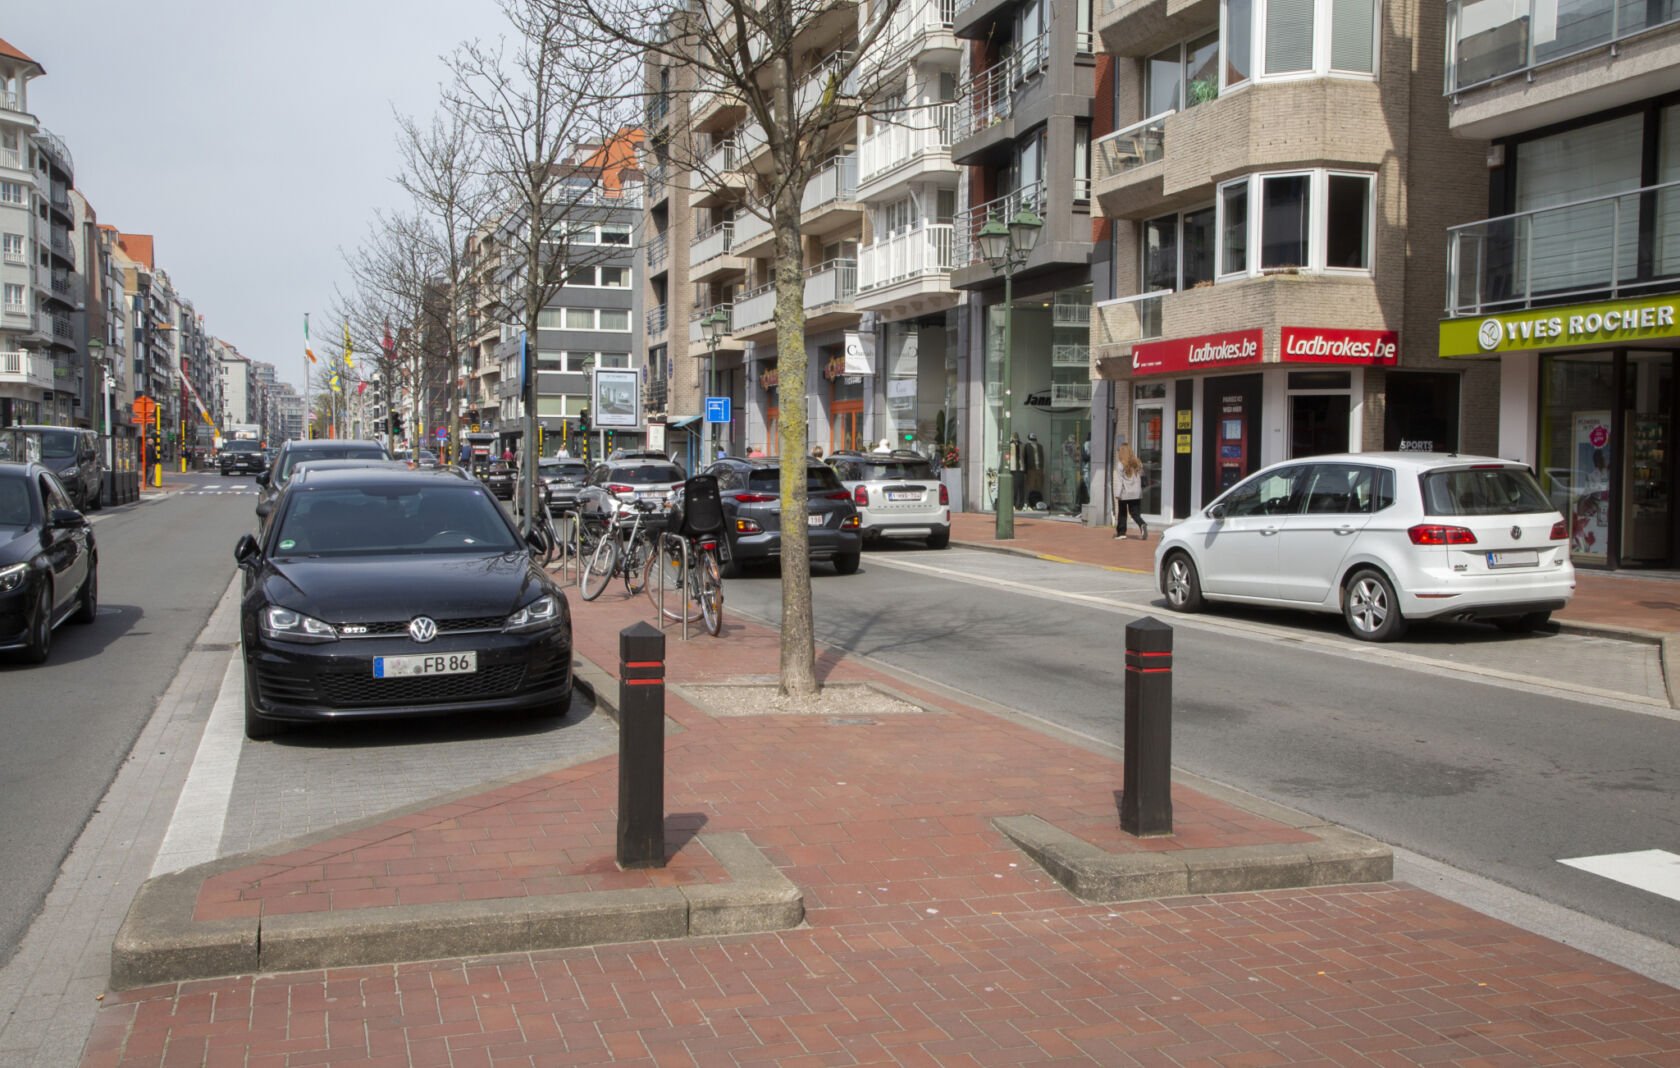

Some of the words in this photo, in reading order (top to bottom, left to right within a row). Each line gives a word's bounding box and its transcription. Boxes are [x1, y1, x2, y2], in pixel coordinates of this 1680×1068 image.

[1506, 317, 1562, 340] YVES
[1568, 305, 1675, 336] ROCHER
[1188, 338, 1257, 362] Ladbrokes.be
[1286, 334, 1396, 359] Ladbrokes.be
[1400, 440, 1433, 450] SPORTS
[343, 626, 367, 634] GTD
[424, 656, 446, 673] FB
[449, 655, 469, 671] 86
